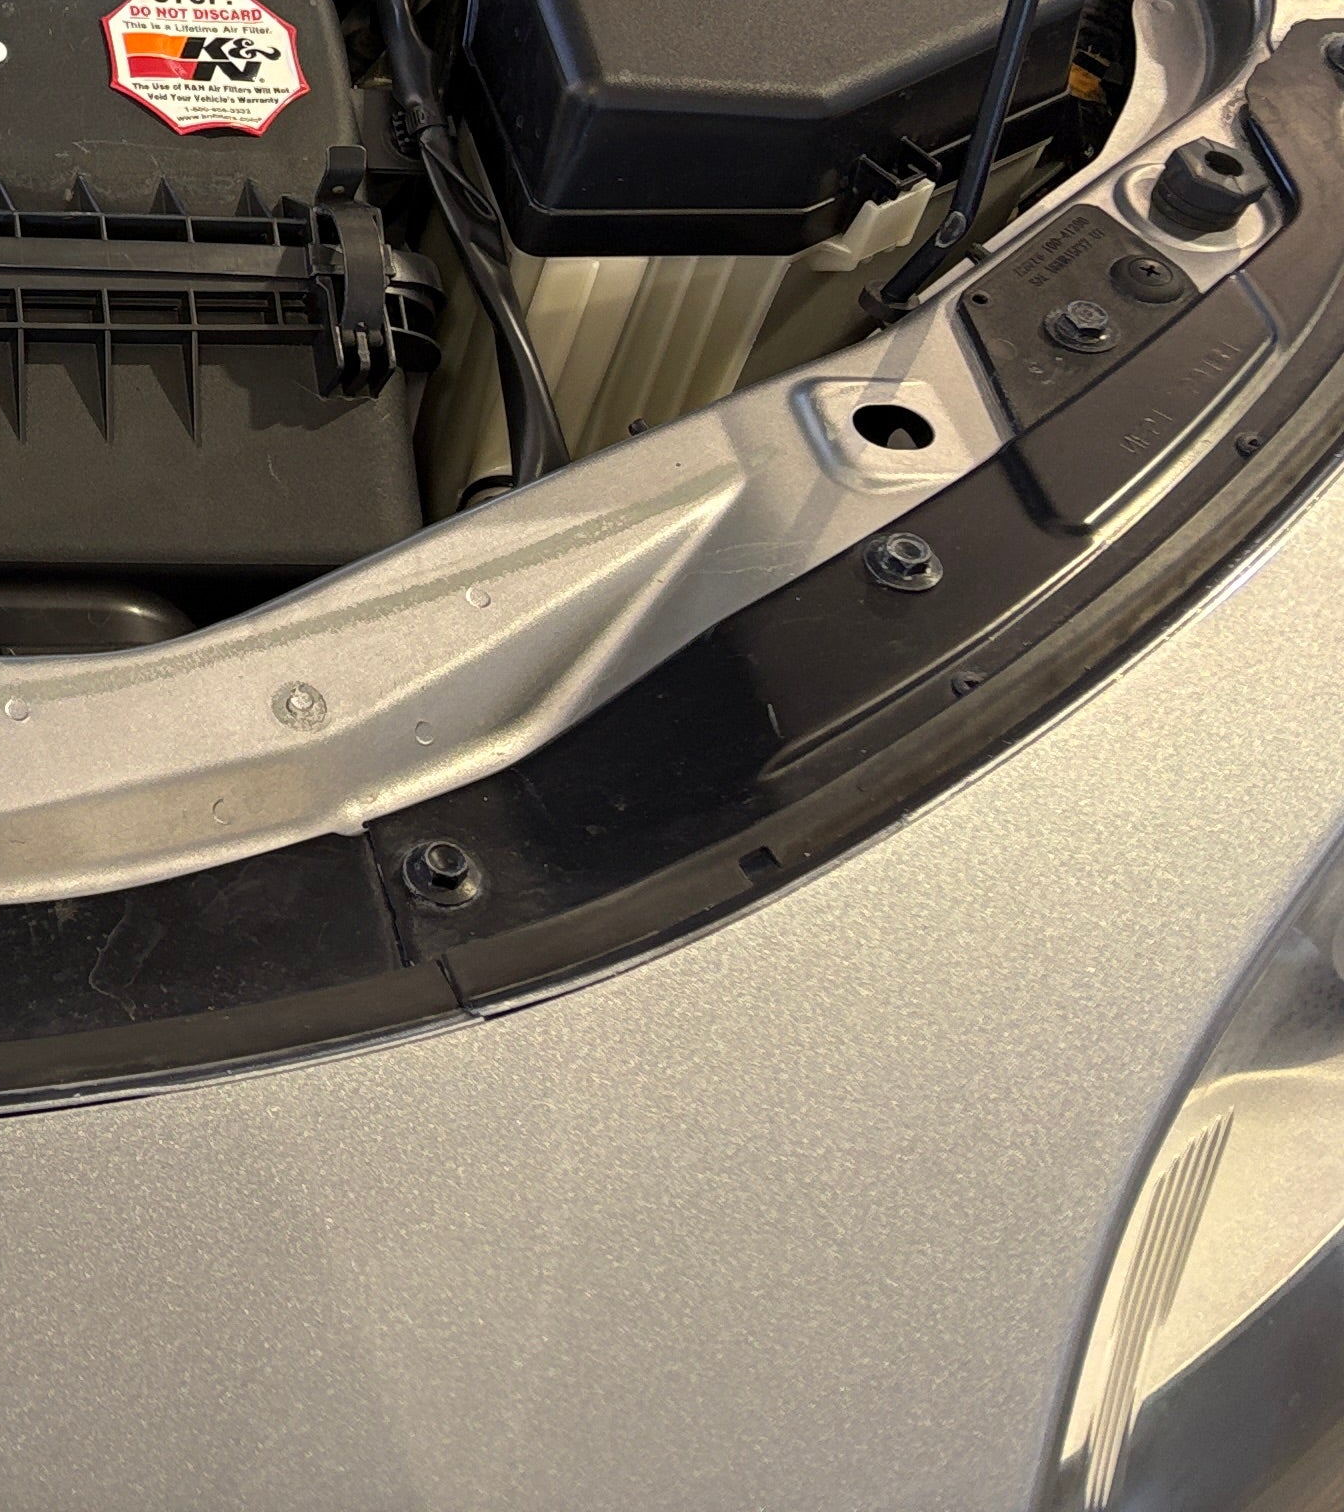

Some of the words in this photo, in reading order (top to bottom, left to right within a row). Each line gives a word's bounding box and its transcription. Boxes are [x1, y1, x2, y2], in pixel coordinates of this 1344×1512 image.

[130, 5, 151, 18] DO
[155, 7, 188, 20] NOT
[193, 8, 263, 22] DISCARD
[123, 20, 147, 30] This
[151, 22, 162, 31] is
[175, 23, 219, 34] Lifetime
[223, 25, 238, 34] Air
[132, 82, 151, 91] The
[152, 83, 170, 91] Use
[172, 83, 182, 91] of
[183, 83, 206, 92] K&N
[208, 84, 221, 92] Air
[223, 85, 252, 94] Filters
[254, 87, 271, 95] Will
[273, 87, 291, 95] Not
[147, 92, 168, 101] Void
[170, 94, 192, 102] Your
[194, 94, 236, 104] Vehicle's
[238, 96, 280, 105] Warranty
